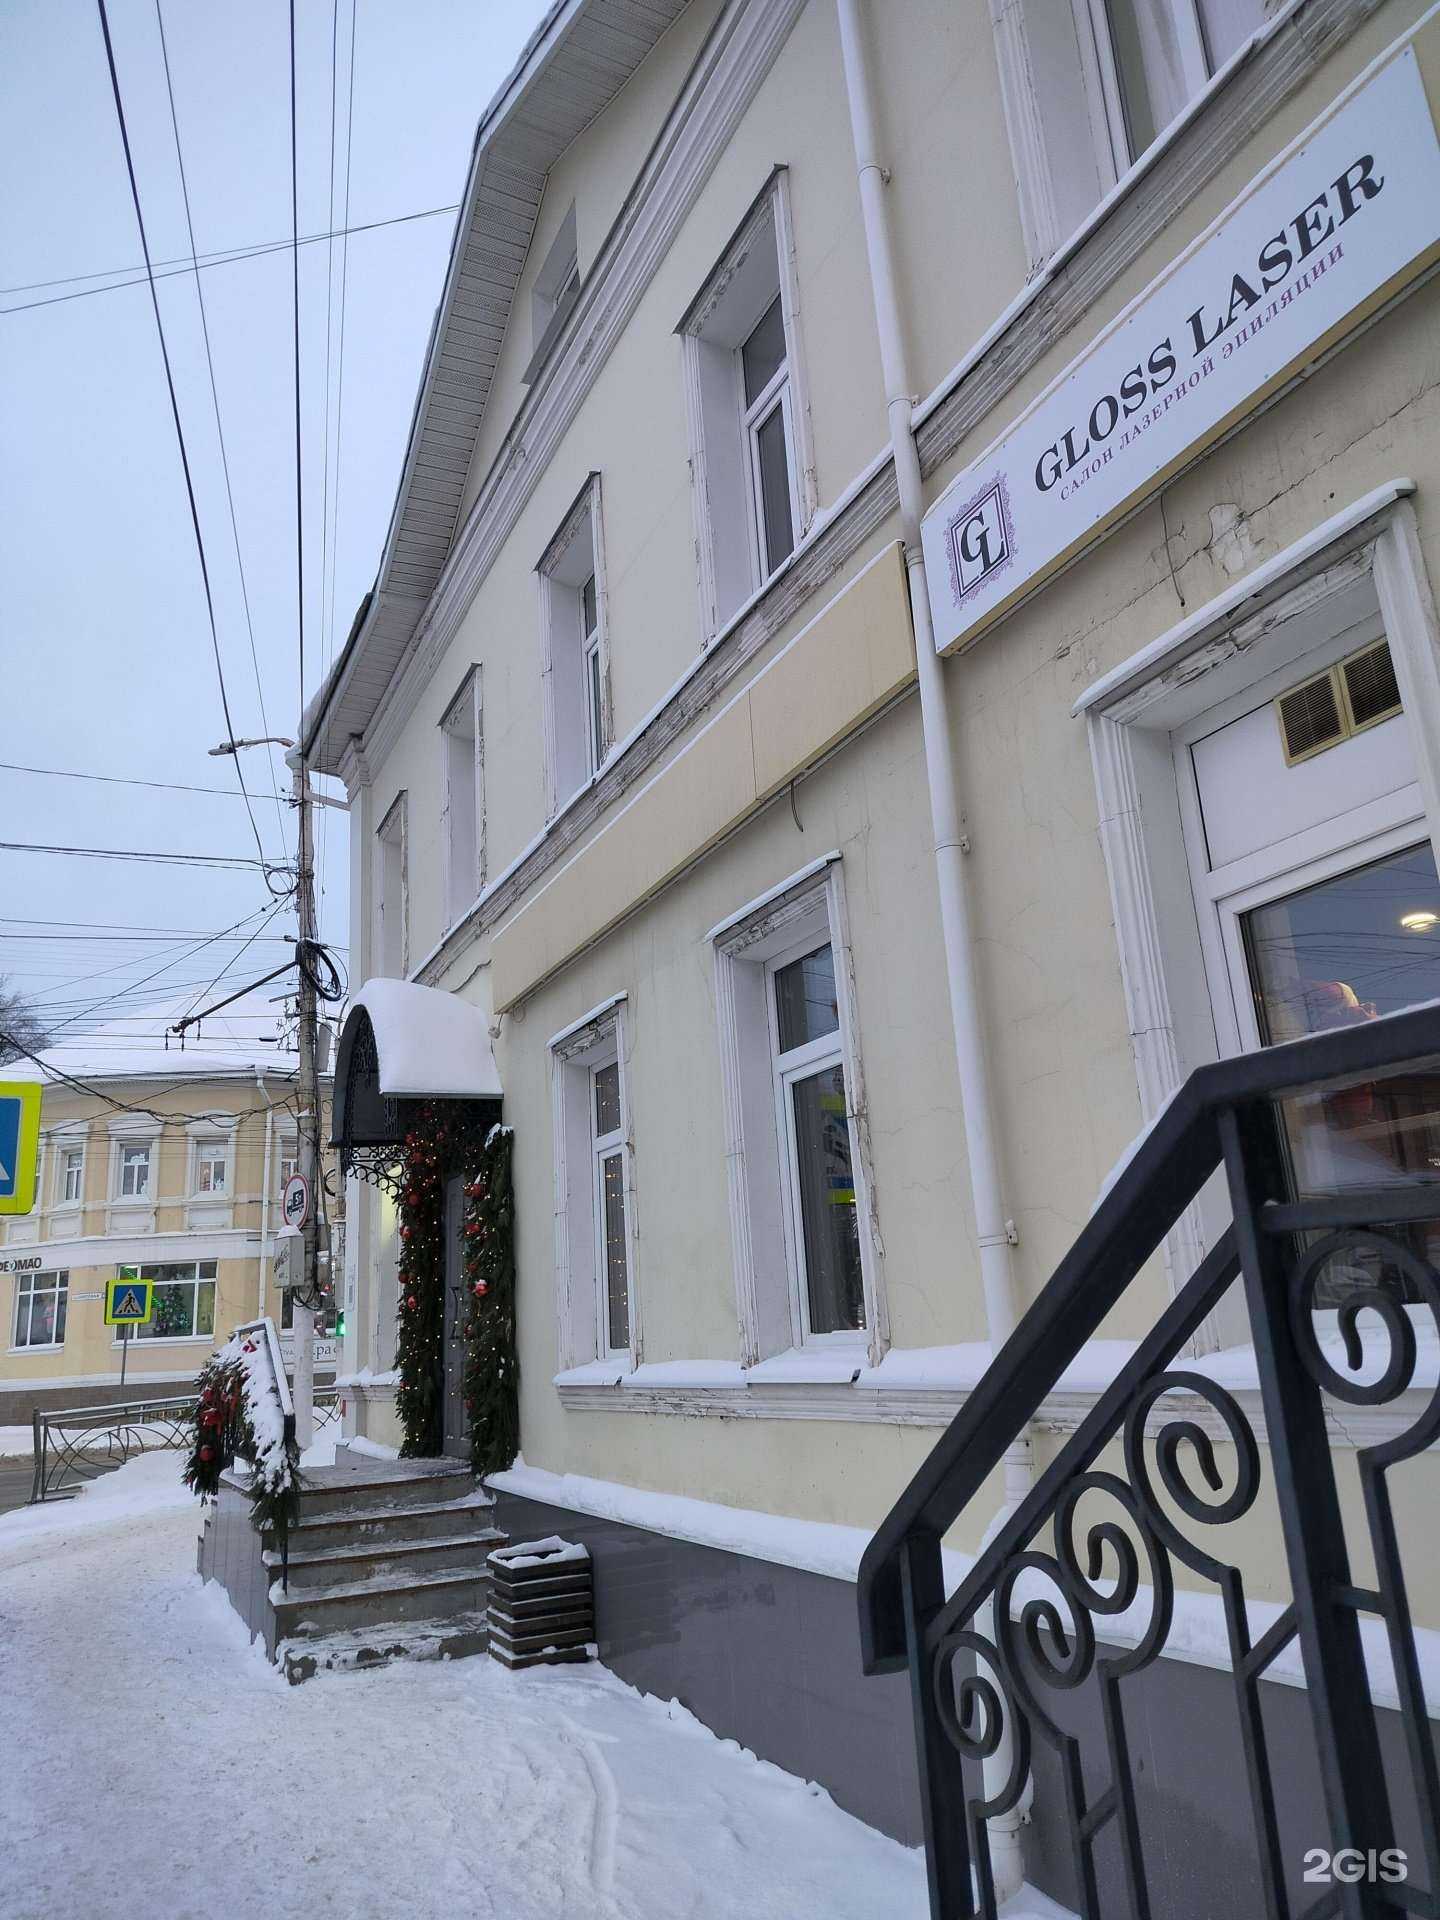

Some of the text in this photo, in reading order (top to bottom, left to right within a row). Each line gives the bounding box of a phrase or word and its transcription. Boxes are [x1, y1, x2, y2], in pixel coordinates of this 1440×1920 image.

[1034, 154, 1385, 492] GLOSS LASER
[1060, 242, 1345, 501] САЛОН ЛАЗЕРНОЙ ЭПИЛЯЦИИ
